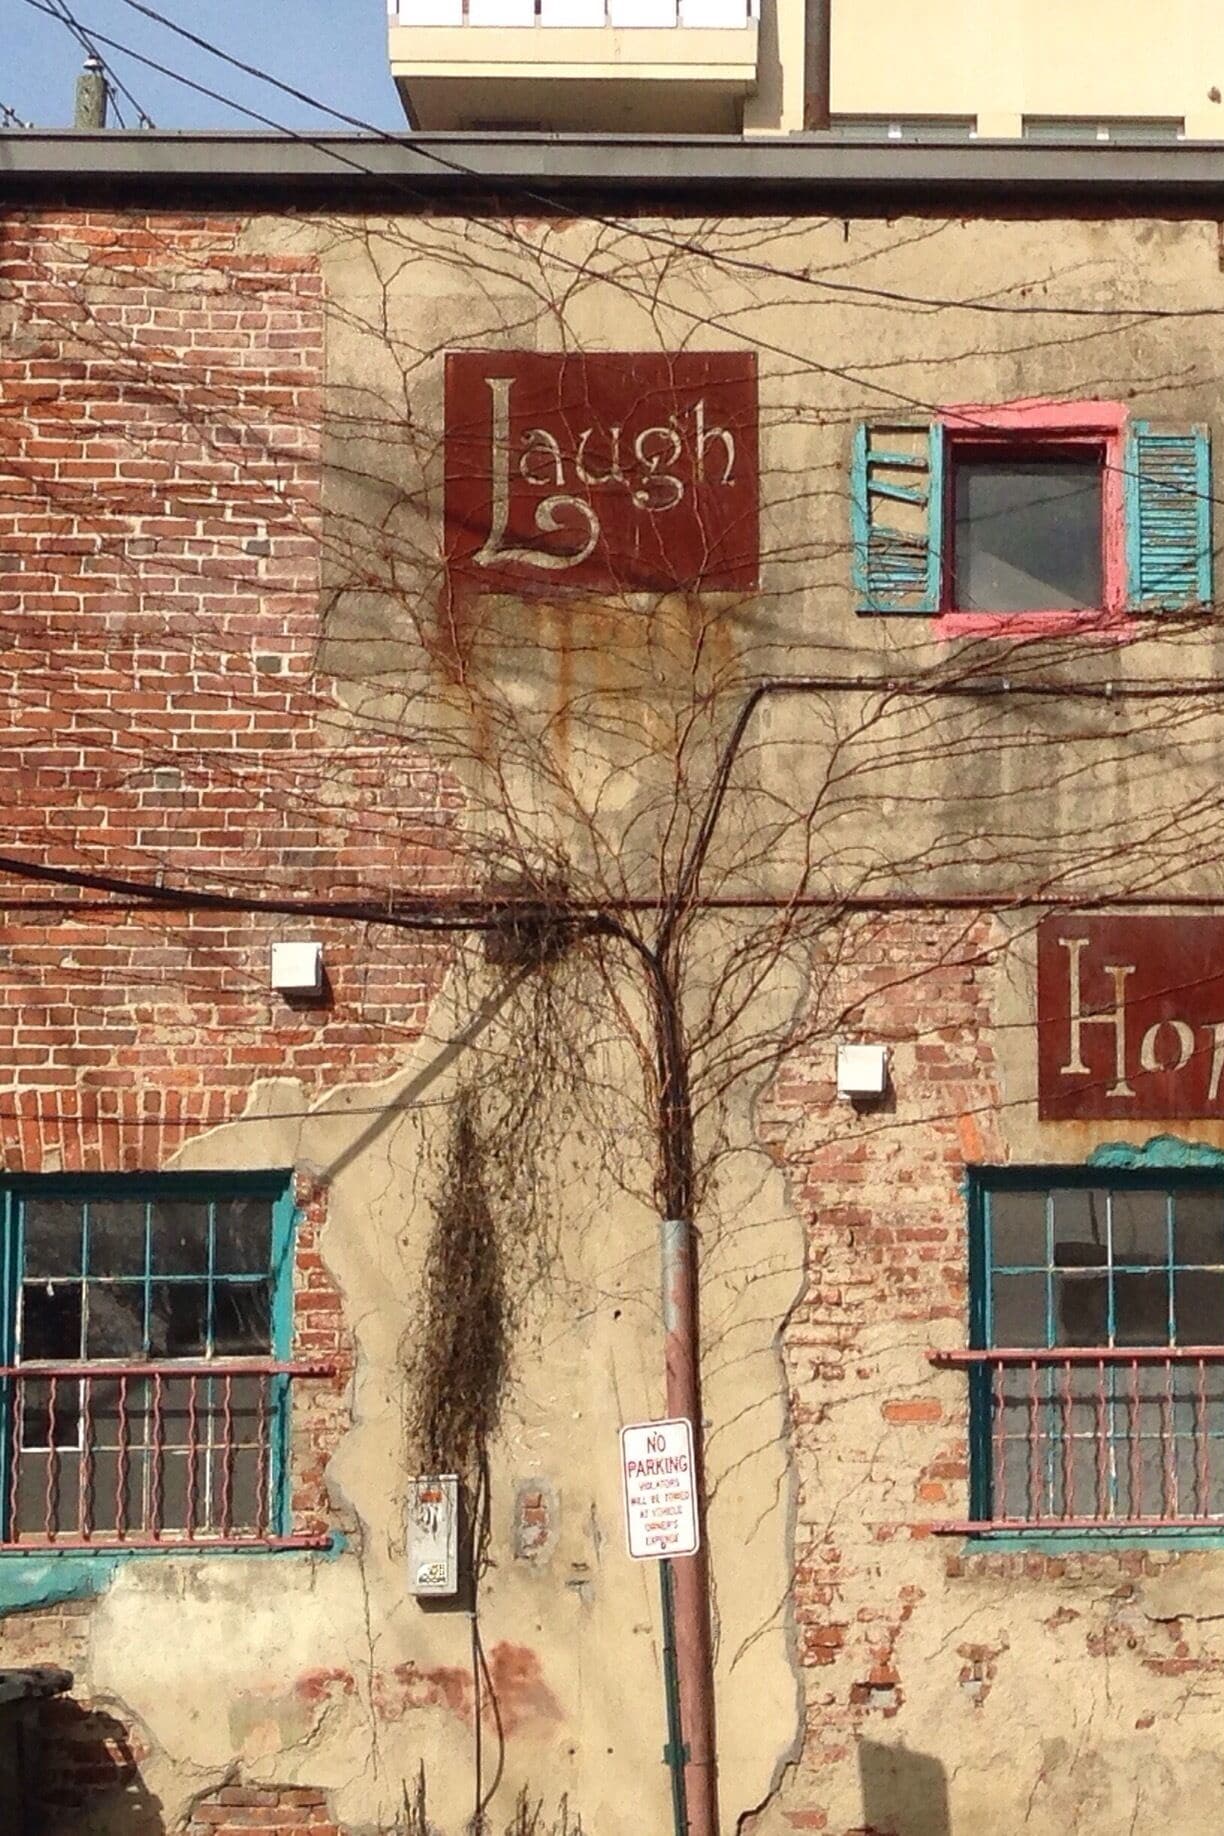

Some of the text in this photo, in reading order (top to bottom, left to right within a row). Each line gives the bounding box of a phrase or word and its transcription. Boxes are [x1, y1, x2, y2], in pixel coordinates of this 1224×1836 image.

[472, 377, 736, 569] Laugh
[647, 1434, 666, 1454] NO
[628, 1455, 688, 1478] PARKING
[639, 1478, 680, 1491] VIOLATORS
